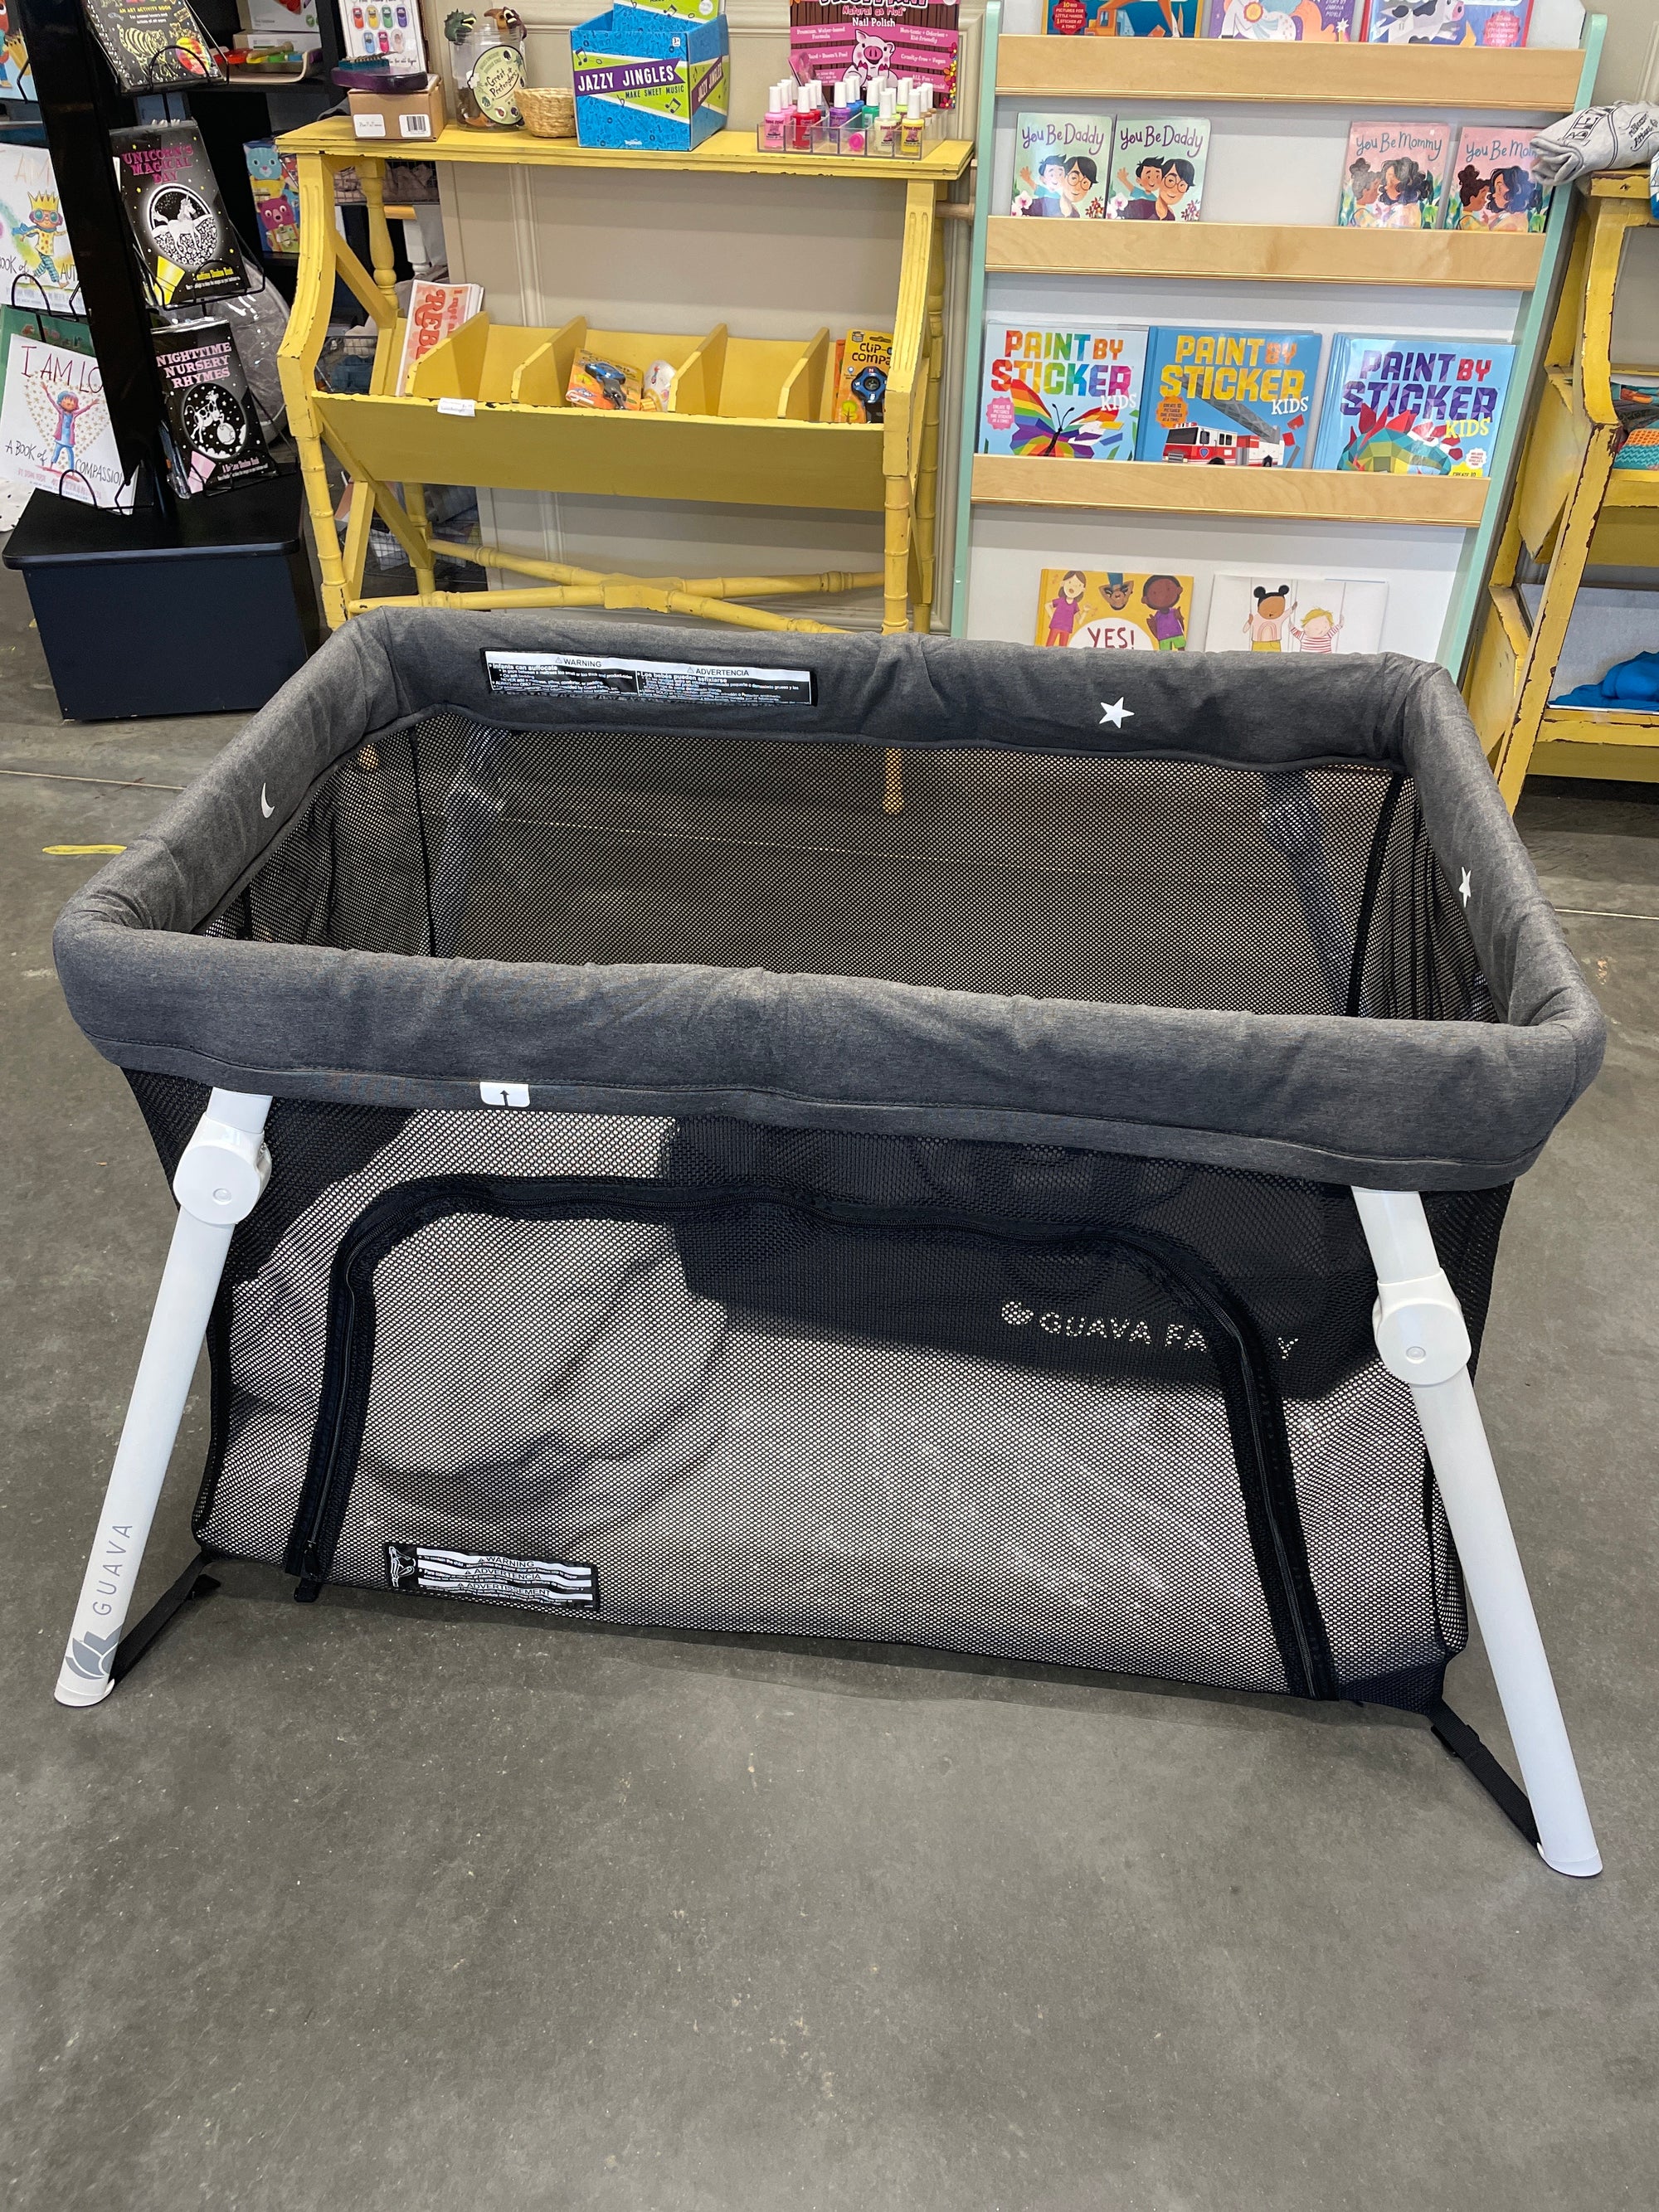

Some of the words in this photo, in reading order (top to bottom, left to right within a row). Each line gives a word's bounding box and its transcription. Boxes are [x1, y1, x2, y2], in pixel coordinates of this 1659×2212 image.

[842, 5, 872, 16] Natural
[852, 17, 868, 27] Nail
[871, 17, 895, 27] Polish
[486, 68, 506, 87] Great
[577, 72, 614, 92] JAZZY
[622, 65, 674, 87] JINGLES
[625, 90, 640, 99] MAKE
[644, 87, 662, 97] SWEET
[665, 85, 684, 94] MUSIC
[1046, 124, 1063, 146] Be
[1063, 123, 1105, 155] Daddy
[1144, 125, 1161, 147] Be
[1161, 125, 1204, 158] Daddy
[1379, 132, 1396, 153] Be
[1399, 131, 1443, 161] Mommy
[1490, 140, 1506, 160] Be
[1508, 139, 1539, 158] Mom
[122, 144, 193, 164] UNICORN'S
[130, 158, 192, 176] MAGICAL
[153, 171, 178, 185] DAY
[0, 255, 17, 274] OOK
[61, 263, 78, 282] AUT
[156, 342, 232, 367] NIGHTTIME
[1005, 329, 1091, 362] PAINT
[1092, 338, 1124, 360] BY
[1175, 335, 1265, 367] PAINT
[1265, 342, 1297, 365] BY
[21, 346, 36, 377] I
[40, 352, 73, 386] AM
[79, 361, 104, 393] LO
[163, 355, 231, 378] NURSERY
[171, 366, 231, 388] RHYMES
[1359, 350, 1457, 382] PAINT
[1457, 358, 1492, 382] BY
[990, 359, 1132, 397] STICKER
[1160, 364, 1306, 402] STICKER
[1100, 393, 1137, 411] KIDS
[1271, 396, 1309, 415] KIDS
[1340, 381, 1498, 422] STICKER
[1445, 417, 1491, 439] KIDS
[5, 440, 12, 455] A
[15, 440, 36, 460] BOOK
[37, 450, 47, 466] of
[1087, 626, 1135, 649] YES!
[563, 658, 602, 668] WARNING
[695, 668, 750, 676] ADVERTENCIA
[1039, 1311, 1152, 1344] GUAVA
[92, 1525, 133, 1616] GUAVA
[486, 1556, 535, 1568] WARNING
[474, 1568, 542, 1580] ADVERTENCIA
[467, 1582, 550, 1597] ADVERTISSEMENT
